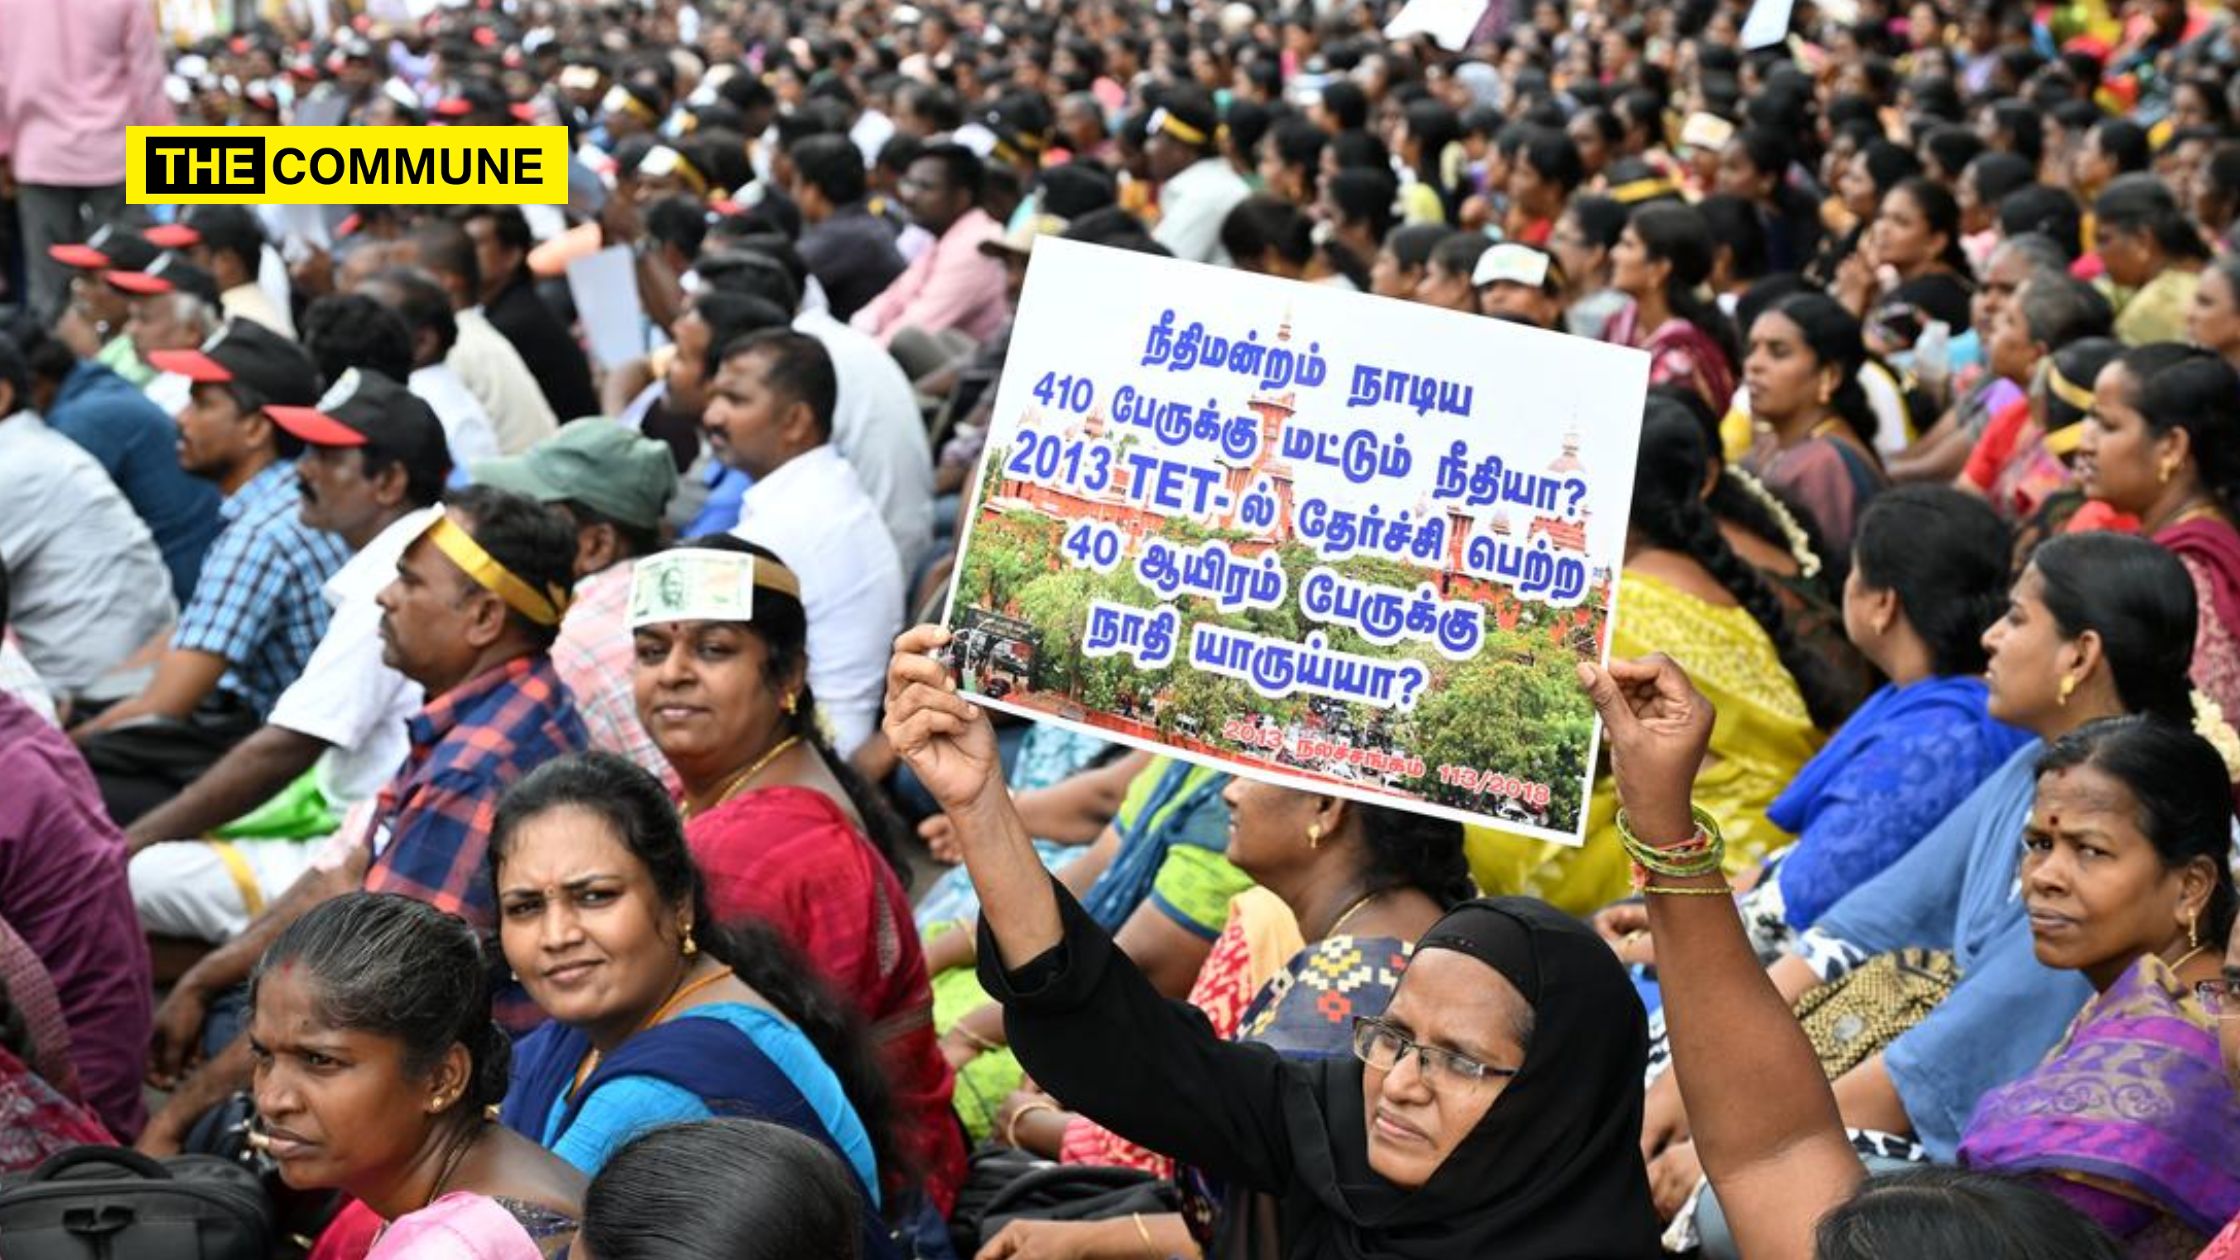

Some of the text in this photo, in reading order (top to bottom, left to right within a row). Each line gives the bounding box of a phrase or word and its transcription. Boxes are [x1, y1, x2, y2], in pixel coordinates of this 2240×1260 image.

[1140, 308, 1474, 418] நீதிமன்றம் நாடிய
[1032, 371, 1588, 517] 410 பேருக்கு மட்டும் நீதியா?
[1008, 428, 1112, 492] 2013
[1298, 498, 1446, 561] தேர்ச்சி
[1467, 535, 1586, 600] பெற்ற
[1066, 524, 1479, 653] 40 ஆயிரம் பேருக்கு
[1087, 606, 1424, 705] நாதி யாருய்யா?
[1223, 720, 1284, 749] 2013
[1438, 764, 1550, 805] 113/2018
